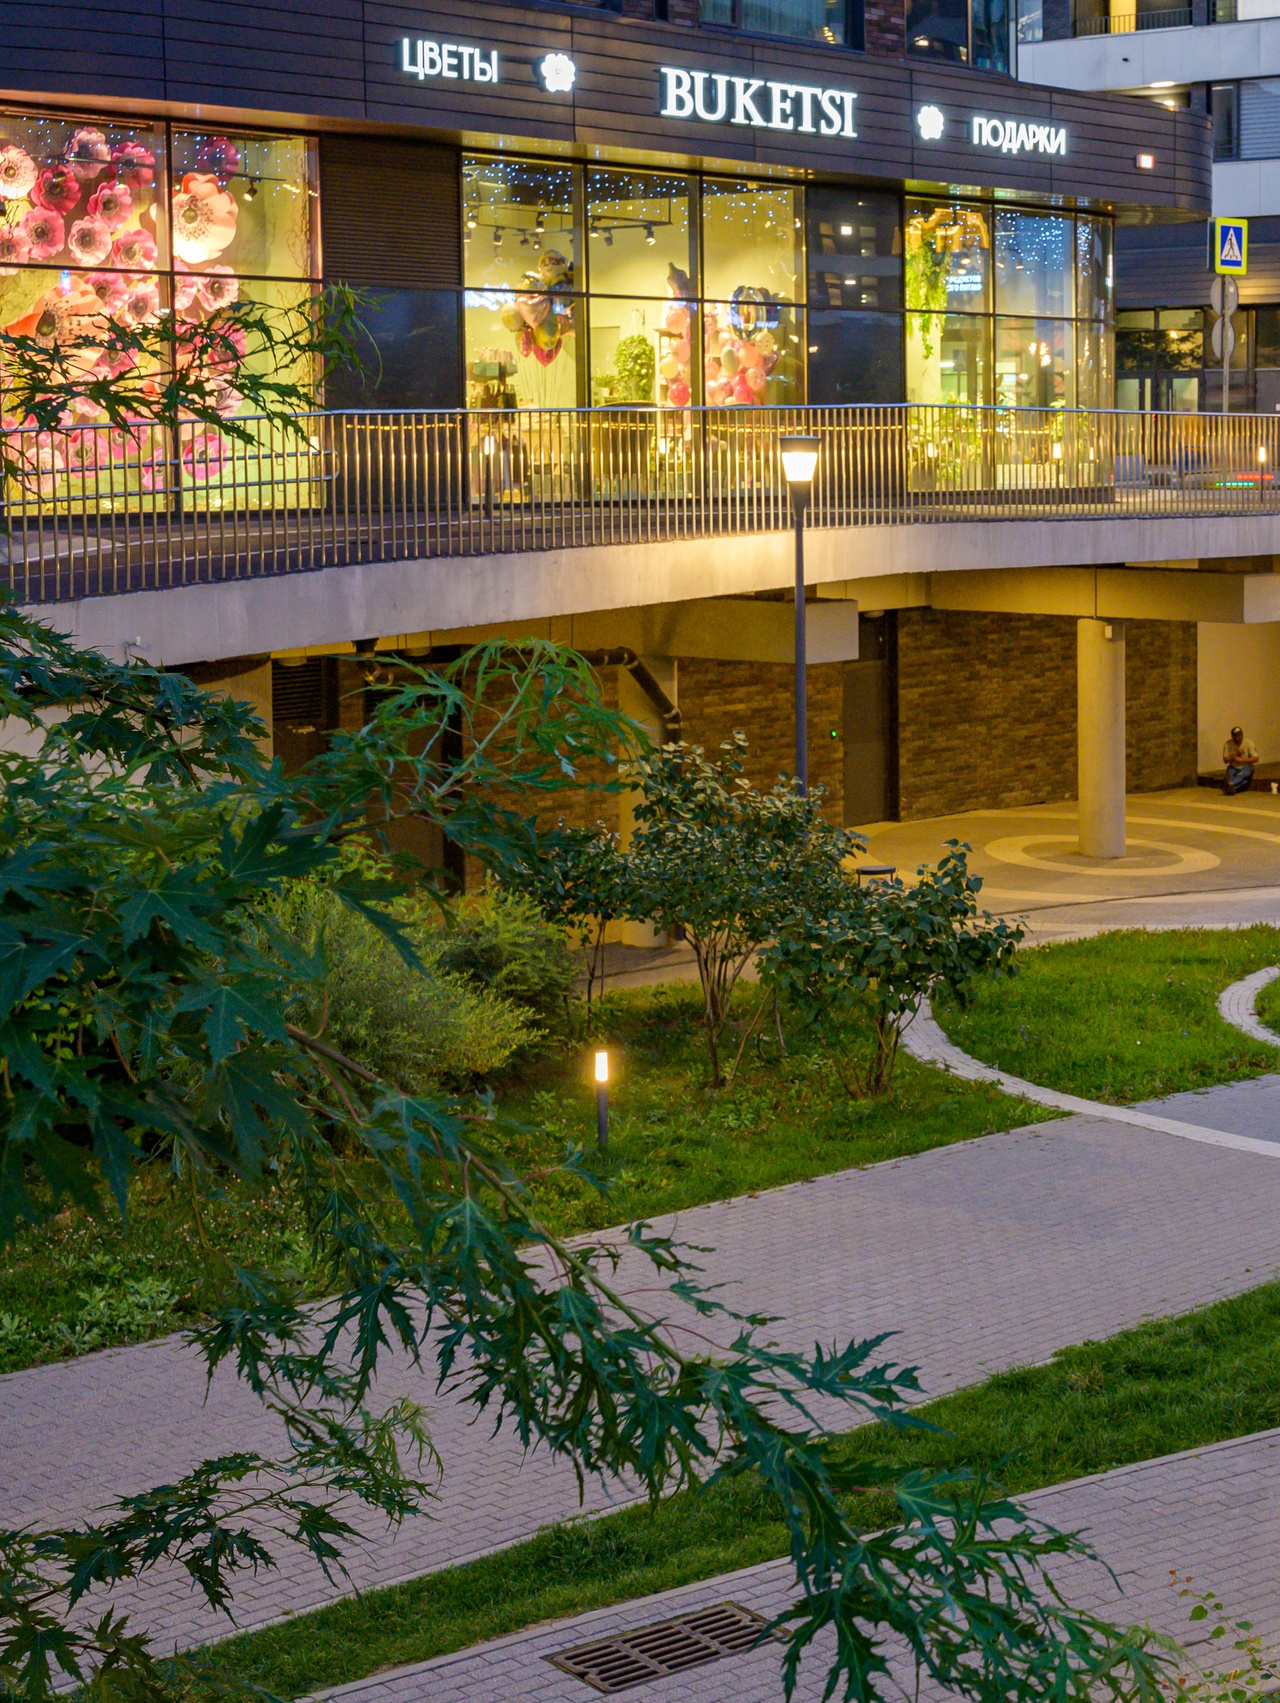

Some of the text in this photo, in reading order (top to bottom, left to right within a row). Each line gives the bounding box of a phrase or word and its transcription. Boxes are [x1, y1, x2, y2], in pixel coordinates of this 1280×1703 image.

[402, 37, 498, 83] ЦВЕТЫ
[660, 67, 858, 138] BUKETSI
[973, 117, 1066, 155] ПОДАРКИ
